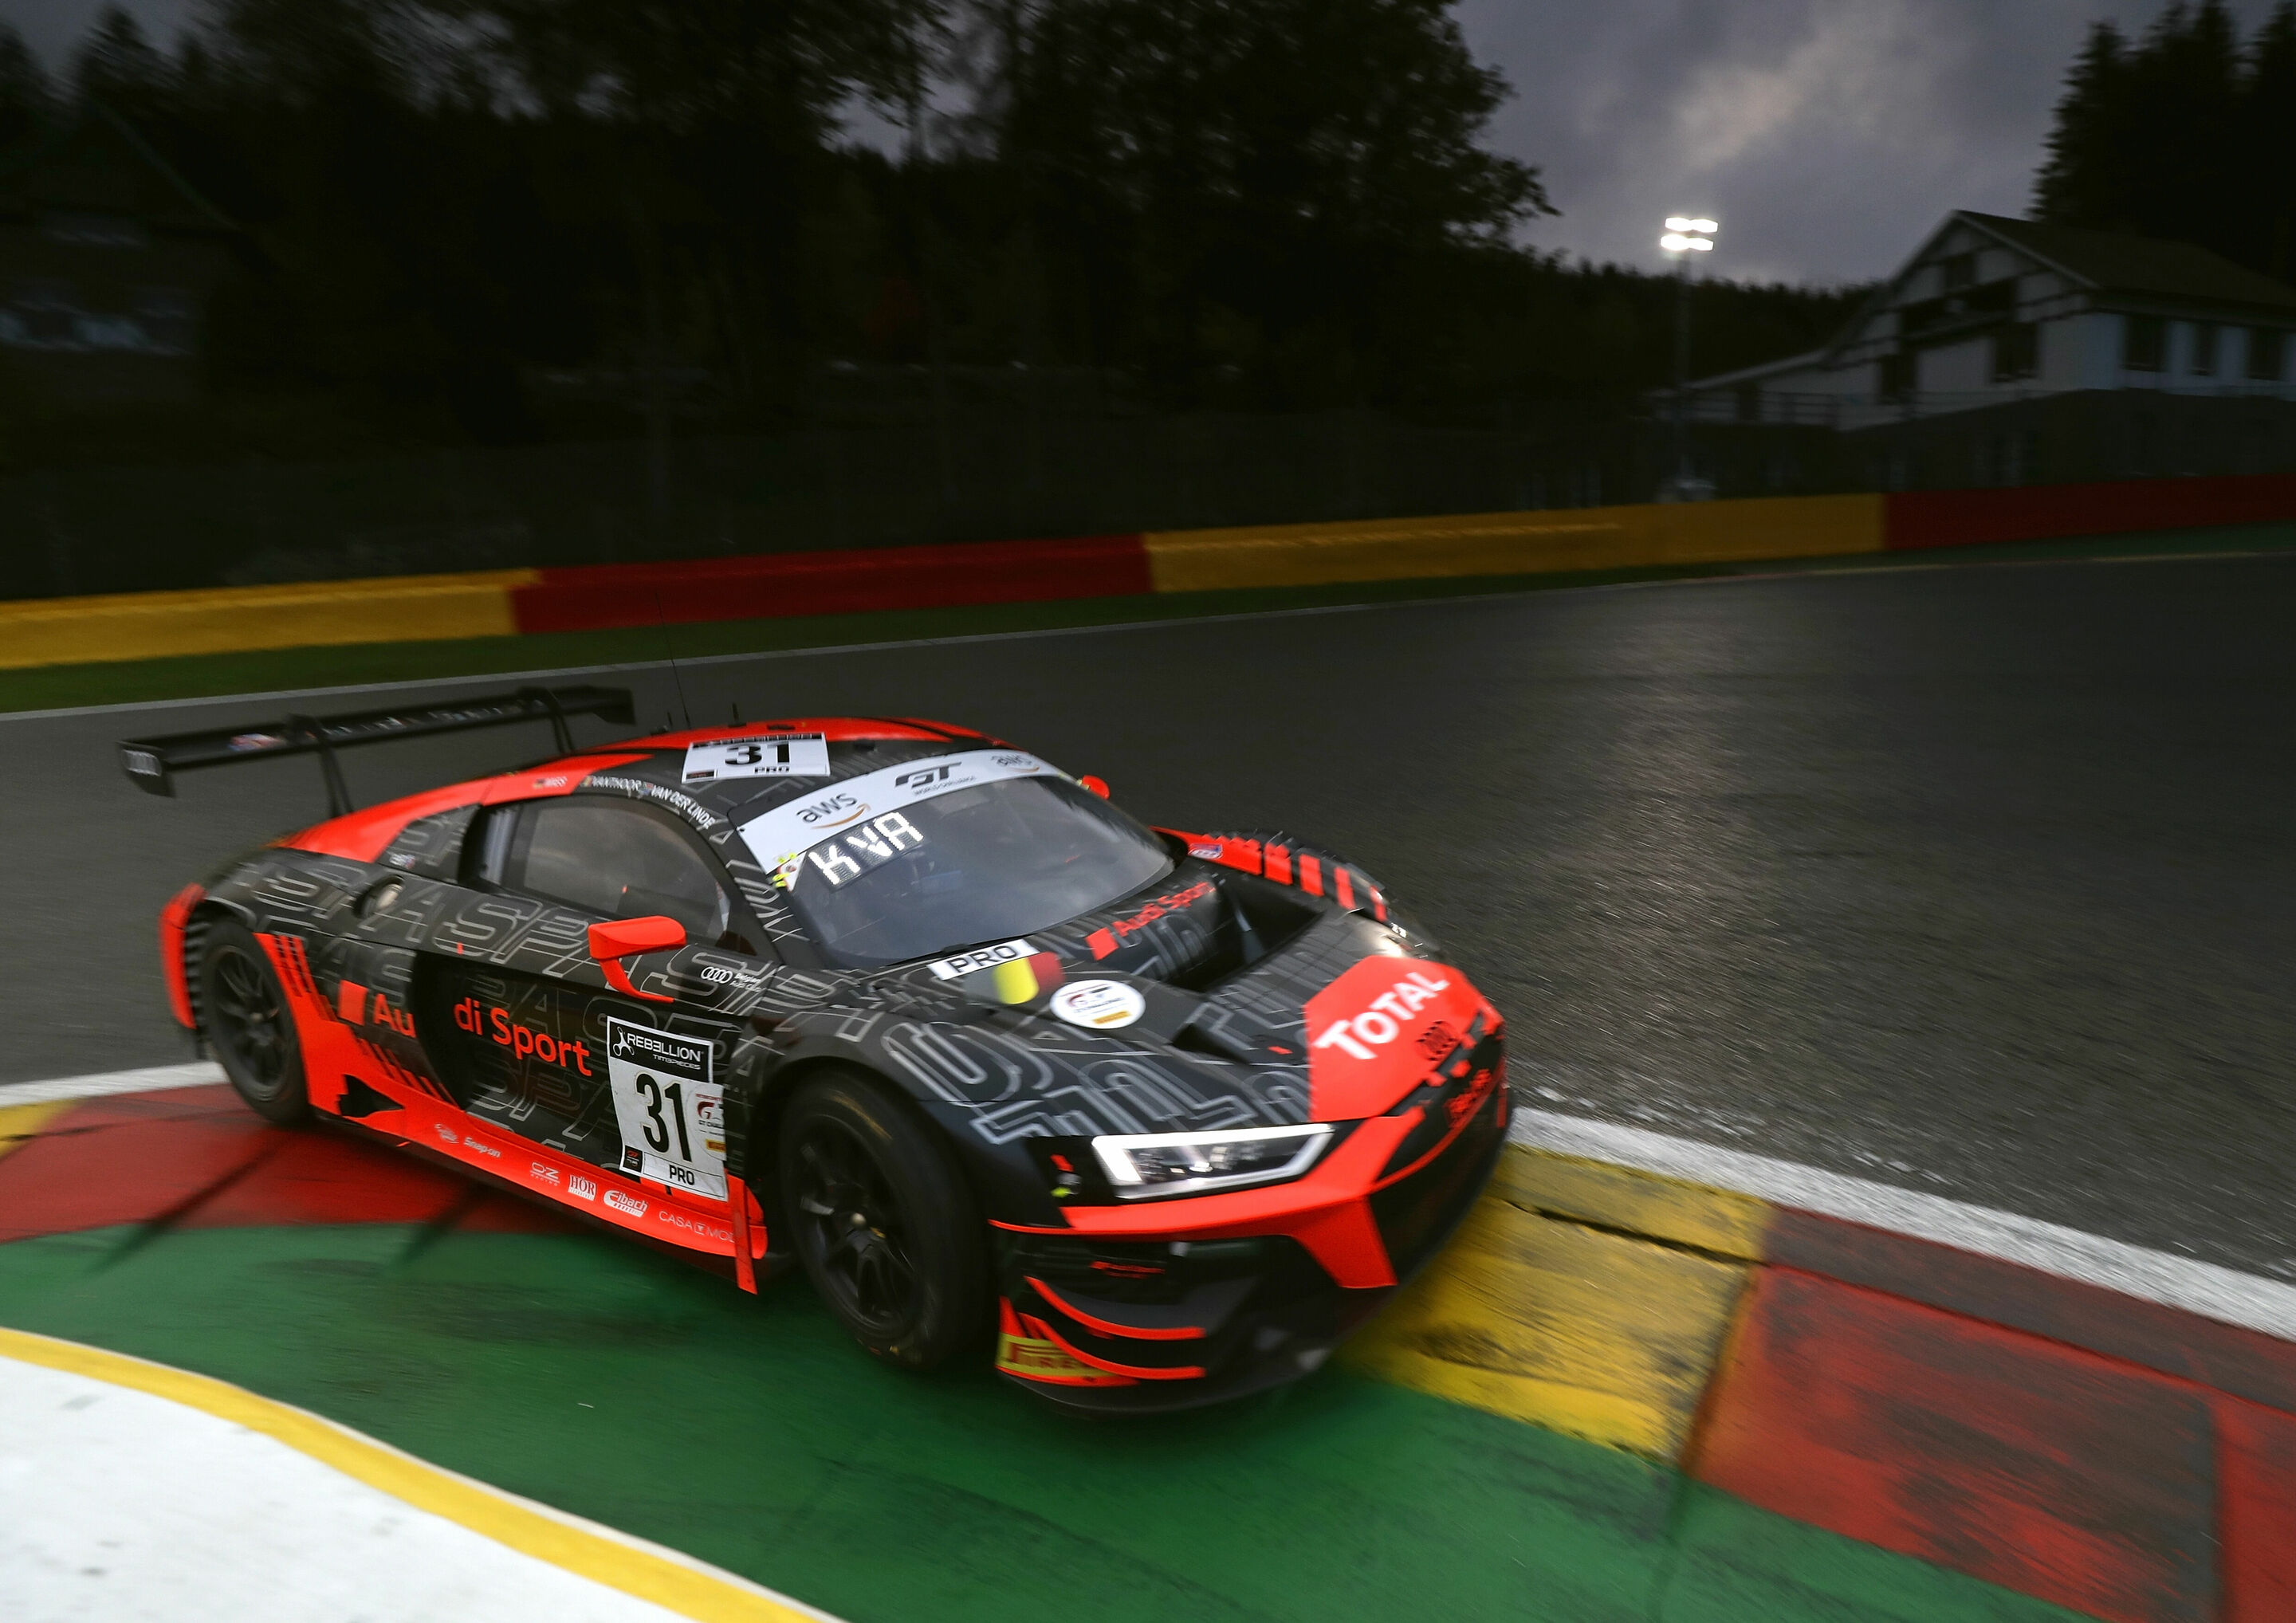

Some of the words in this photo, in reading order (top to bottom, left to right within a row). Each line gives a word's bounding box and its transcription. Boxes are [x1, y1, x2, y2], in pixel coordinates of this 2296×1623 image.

[725, 741, 790, 765] 31
[894, 761, 961, 788] GT
[651, 785, 672, 802] VAN
[670, 792, 692, 812] DER
[688, 803, 716, 830] LINDE
[796, 792, 858, 823] aws
[1111, 903, 1167, 937] Audi
[946, 945, 1019, 974] PRO
[1312, 972, 1451, 1060] TOTAL
[489, 1007, 592, 1077] Sport
[627, 1032, 702, 1063] REBELLION
[636, 1073, 692, 1162] 31
[463, 1137, 501, 1158] Snap-on
[531, 1161, 559, 1180] OZ
[669, 1165, 695, 1185] PRO
[603, 1189, 648, 1216] Eibach
[659, 1211, 693, 1230] CASA
